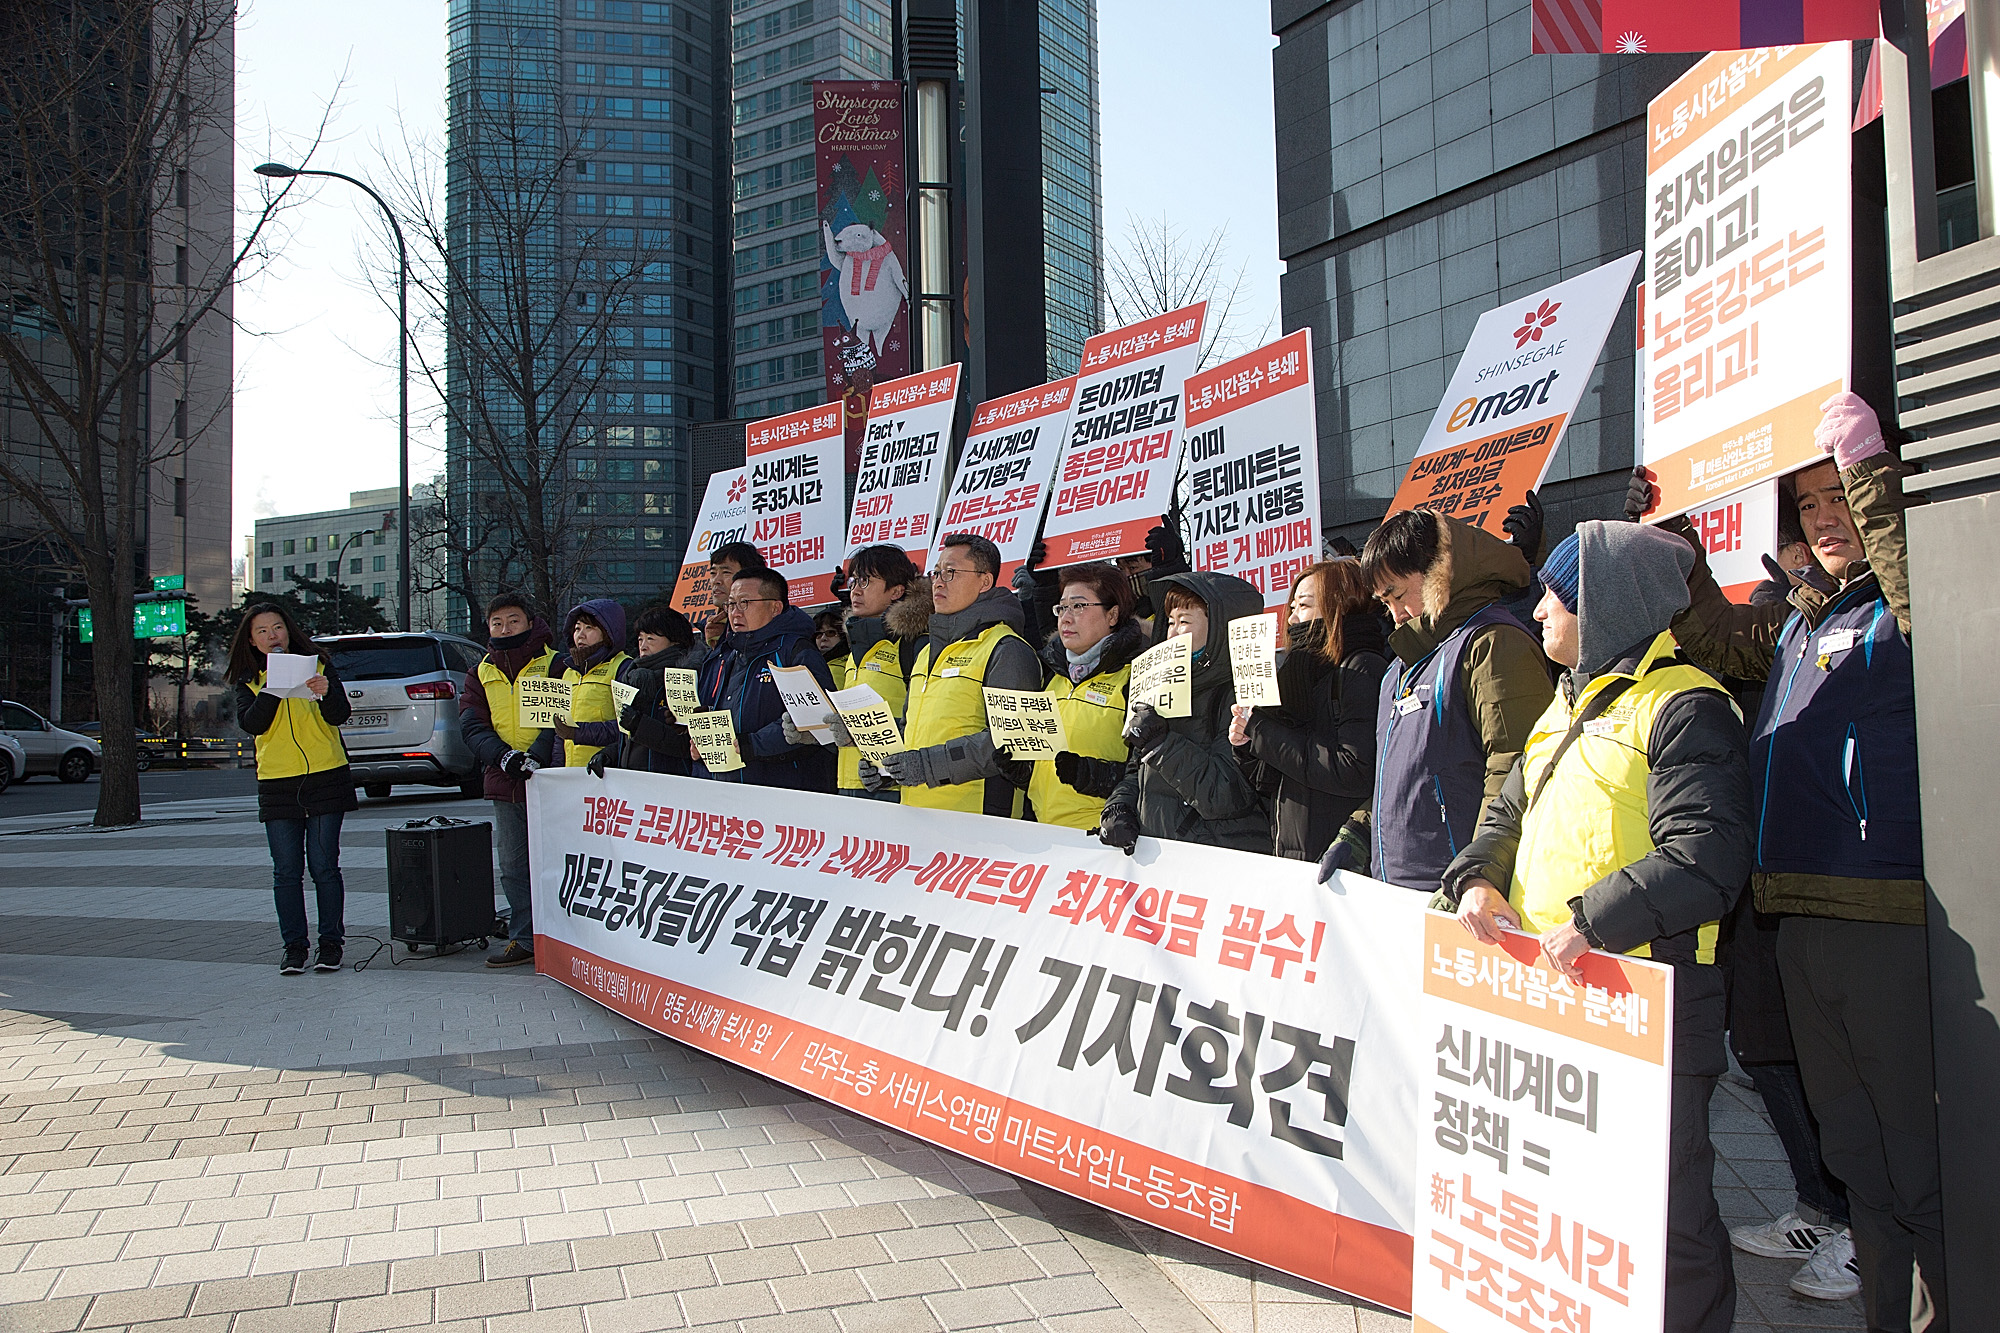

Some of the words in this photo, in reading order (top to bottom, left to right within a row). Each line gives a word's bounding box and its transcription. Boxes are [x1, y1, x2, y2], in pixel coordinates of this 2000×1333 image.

[816, 90, 899, 114] Shinsegae
[836, 109, 881, 129] Loves
[1653, 46, 1770, 153] 노동시간꼼수
[818, 123, 900, 144] Christmas
[1654, 75, 1825, 239] 최저임금은
[1654, 185, 1759, 300] 줄이고!
[1653, 226, 1825, 361] 노동강도는
[1084, 330, 1160, 368] 노동시간꼼수
[1163, 318, 1196, 343] 분쇄!
[1474, 339, 1567, 383] SHINSEGAE
[1077, 364, 1165, 415] 돈아끼려
[1189, 364, 1265, 413] 노동시간꼼수
[1267, 350, 1300, 383] 분쇄!
[1653, 321, 1759, 425] 올리고!
[873, 390, 927, 411] 노동시간꼼수
[928, 377, 952, 397] 분쇄!
[975, 399, 1039, 427] 노동시간꼼수
[1041, 387, 1069, 408] 분쇄!
[1446, 369, 1560, 433] emart
[750, 420, 810, 447] 노동시간꼼수
[812, 413, 837, 433] 분쇄!
[867, 420, 893, 442] Fact
[1070, 393, 1180, 448] 잔머리말고
[864, 443, 879, 468] 돈
[880, 431, 940, 464] 아끼려고
[965, 426, 1041, 468] 신세계의
[1062, 429, 1174, 482] 좋은일자리
[1190, 425, 1225, 463] 이미
[1411, 422, 1554, 481] 신세계-이마트의
[1705, 434, 1773, 475] 마트산업노동조합
[752, 454, 819, 487] 신세계는
[858, 467, 890, 494] 23시
[891, 460, 922, 488] 폐점
[955, 457, 1032, 496] 사기행각
[1192, 443, 1302, 507] 롯데마트는
[1428, 459, 1506, 498] 최저임금
[1705, 478, 1725, 492] Korean
[1725, 473, 1737, 484] Mart
[1738, 466, 1754, 478] Labor
[1755, 460, 1773, 472] Union
[752, 479, 823, 514] 주35시간
[855, 493, 893, 518] 늑대가
[946, 483, 1041, 526] 마트노조로
[1055, 469, 1150, 517] 만들어라!
[1193, 500, 1240, 541] 7시간
[1244, 481, 1304, 528] 시행중
[1462, 482, 1503, 511] 꼼수
[752, 512, 802, 543] 사기를
[850, 521, 876, 545] 양의
[878, 519, 892, 541] 탈
[893, 517, 908, 538] 쓴
[910, 513, 930, 536] 꼴!
[1195, 540, 1228, 571] 나쁜
[1233, 534, 1251, 564] 거
[1256, 517, 1312, 559] 베끼며
[682, 593, 709, 609] 무력화
[521, 680, 571, 695] 인원충원없는
[521, 696, 571, 711] 근로시간단축은
[987, 694, 1017, 712] 최저임금
[1020, 697, 1053, 713] 무력화
[358, 715, 382, 726] 2599
[990, 715, 1025, 733] 이마트의
[1027, 718, 1058, 734] 꼼수를
[582, 796, 635, 839] 고용없는
[634, 804, 765, 861] 근로시간단축은
[762, 824, 826, 868] 기만!
[818, 835, 1050, 914] 신세계-이마트의
[1048, 869, 1208, 958] 최저임금
[1217, 903, 1327, 984] 꼼수!
[558, 853, 745, 955] 마트노동자들이
[730, 889, 829, 978] 직접
[808, 905, 1020, 1038] 밝힌다!
[1014, 956, 1356, 1161] 기자회견
[1431, 943, 1576, 1016] 노동시간꼼수
[1582, 982, 1649, 1038] 분쇄!
[571, 956, 590, 986] 2017년
[631, 980, 651, 1012] 11시
[663, 992, 687, 1024] 명동
[685, 1000, 726, 1038] 신세계
[721, 1012, 754, 1048] 본사
[750, 1023, 773, 1055] 앞
[799, 1041, 880, 1097] 민주노총
[879, 1071, 1001, 1144] 서비스연맹
[1003, 1115, 1242, 1235] 마트산업노동조합
[1436, 1023, 1599, 1134] 신세계의
[1434, 1091, 1510, 1175] 정책
